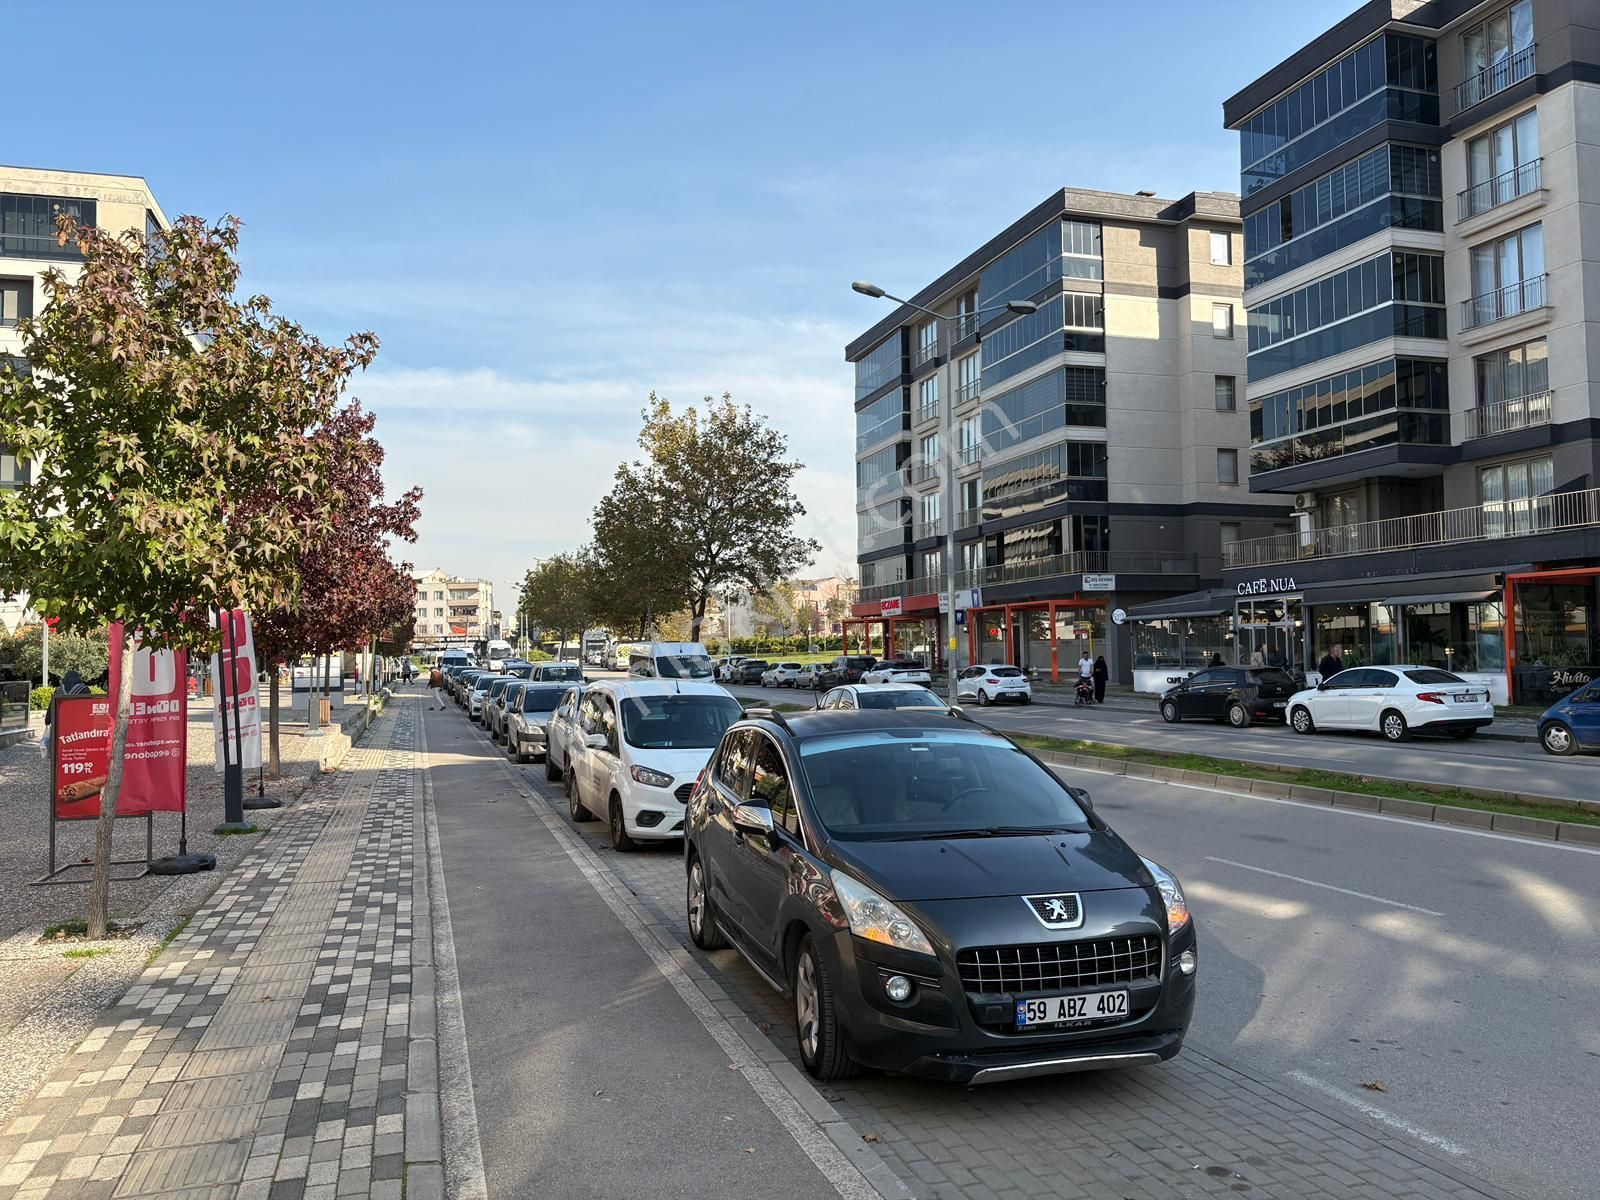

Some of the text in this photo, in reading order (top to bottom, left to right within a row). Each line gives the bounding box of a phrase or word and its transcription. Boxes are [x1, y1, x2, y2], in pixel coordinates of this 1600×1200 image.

[1270, 577, 1296, 592] NUA
[62, 762, 84, 774] 119
[1026, 994, 1126, 1022] 59 ABZ 402
